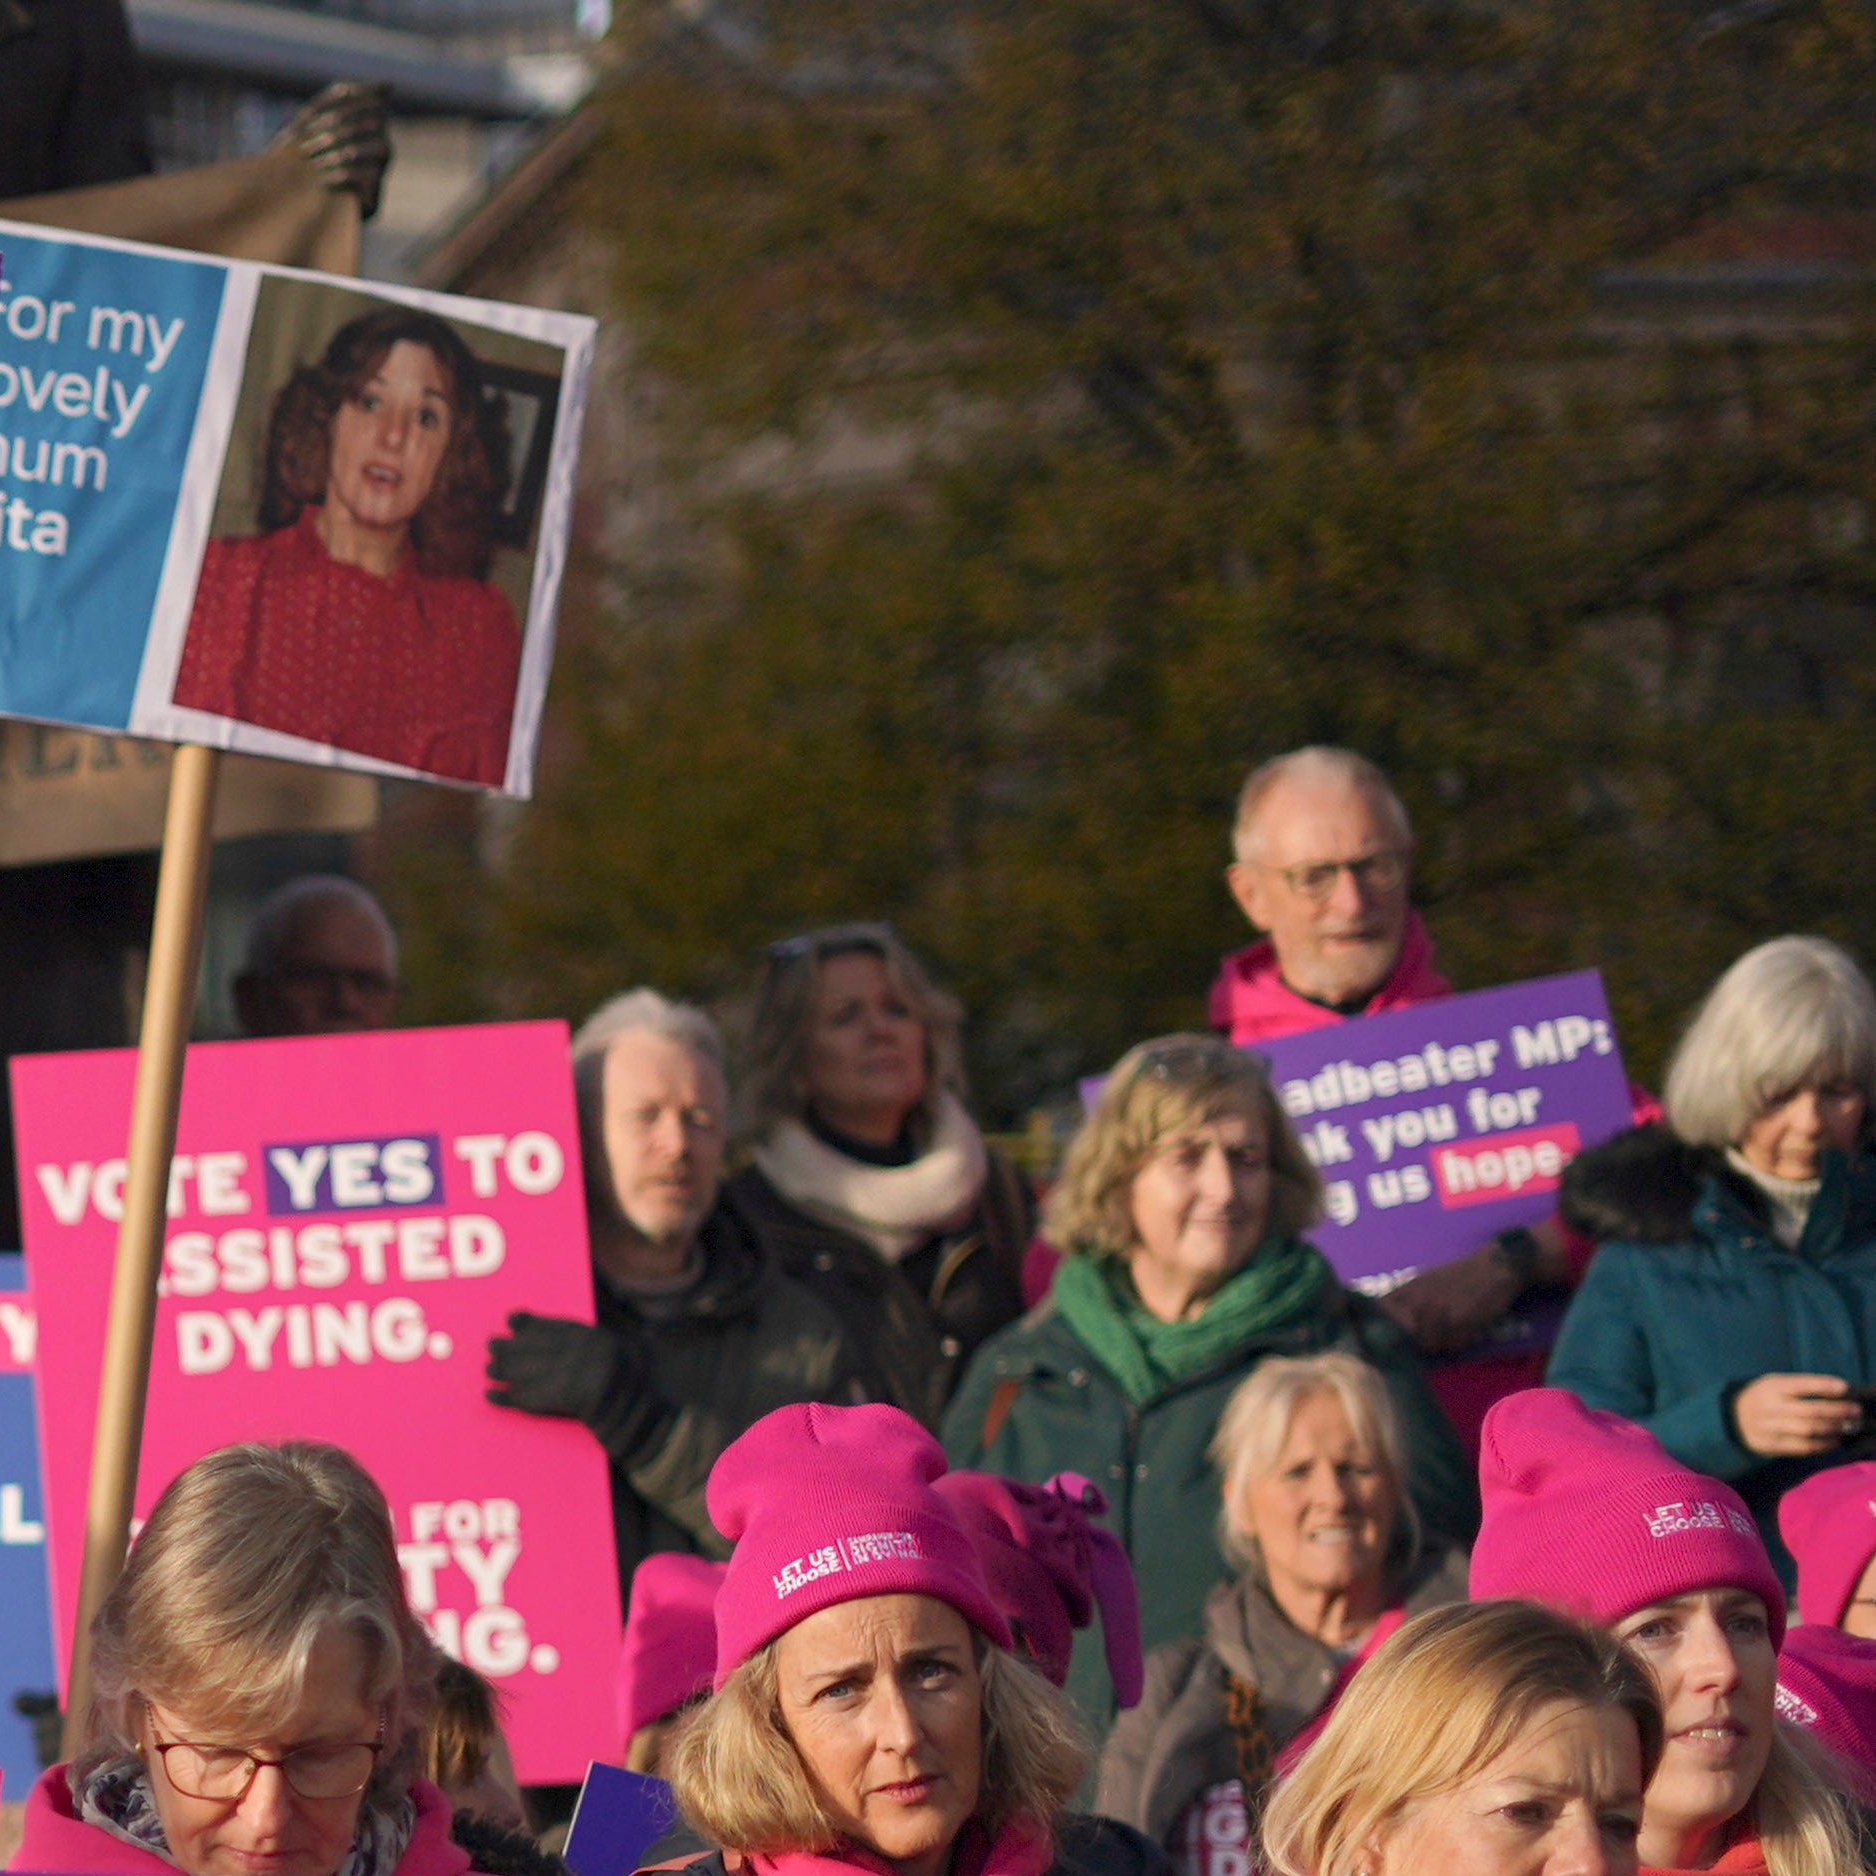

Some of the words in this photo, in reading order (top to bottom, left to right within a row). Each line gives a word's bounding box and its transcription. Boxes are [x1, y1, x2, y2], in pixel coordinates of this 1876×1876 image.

[88, 305, 184, 373] my
[1280, 1040, 1499, 1117] adbeater
[1512, 1015, 1613, 1069] MP:
[1362, 1103, 1457, 1163] you
[1467, 1086, 1542, 1133] for
[269, 1139, 434, 1211] YES
[454, 1131, 564, 1196] TO
[1367, 1165, 1431, 1209] us
[158, 1214, 505, 1298] SSISTED
[176, 1299, 452, 1375] DYING.
[410, 1498, 521, 1542] FOR
[1642, 1502, 1683, 1526] LET
[1691, 1501, 1716, 1516] US
[1649, 1516, 1725, 1538] CHOOSE
[772, 1557, 803, 1589] LET
[808, 1545, 837, 1568] US
[778, 1559, 843, 1600] CHOOSE
